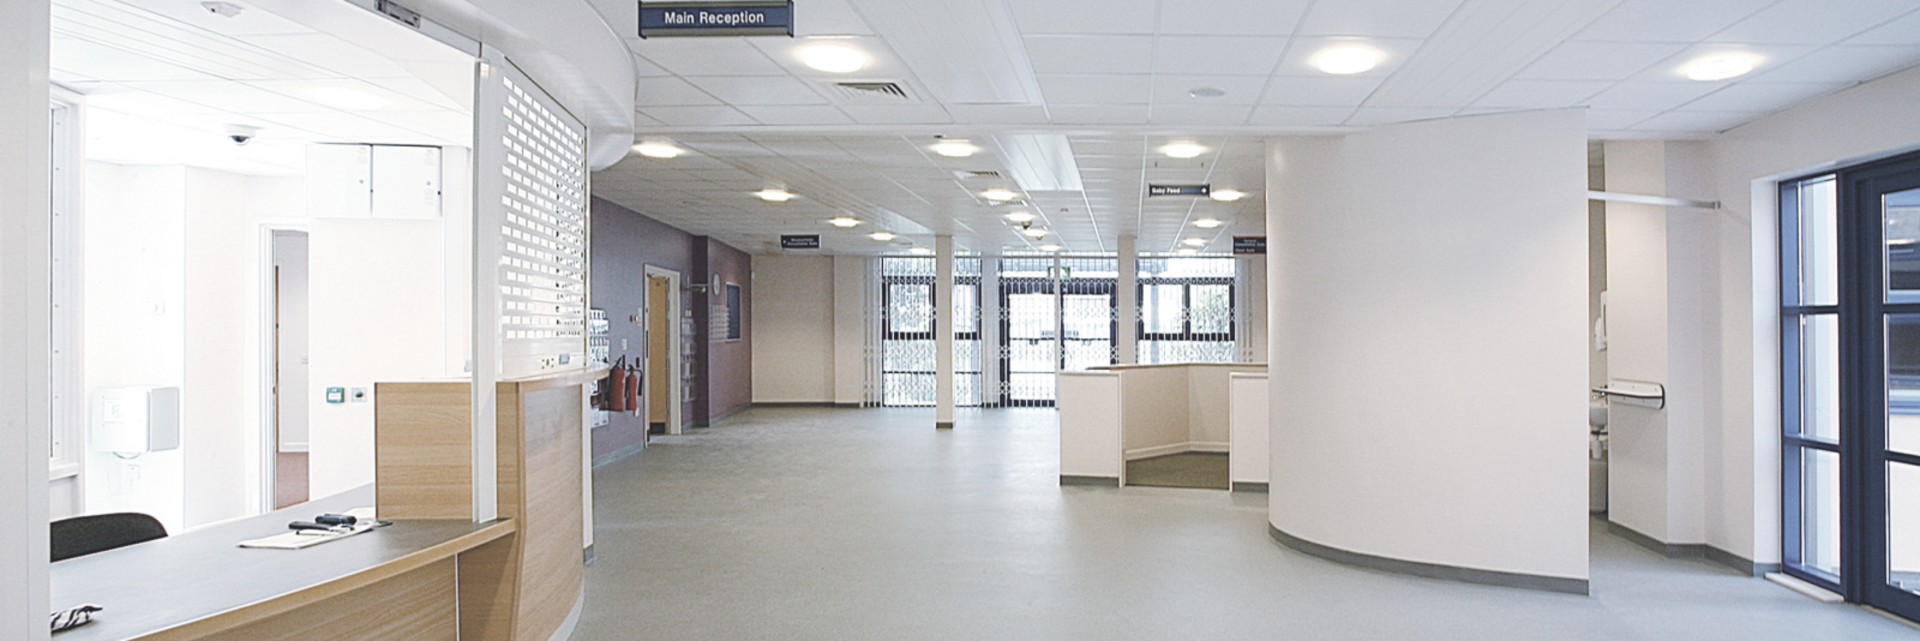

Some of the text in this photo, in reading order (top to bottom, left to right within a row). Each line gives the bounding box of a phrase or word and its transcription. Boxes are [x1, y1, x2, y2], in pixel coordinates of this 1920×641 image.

[664, 11, 764, 26] Main Reception
[1151, 187, 1165, 195] Baby
